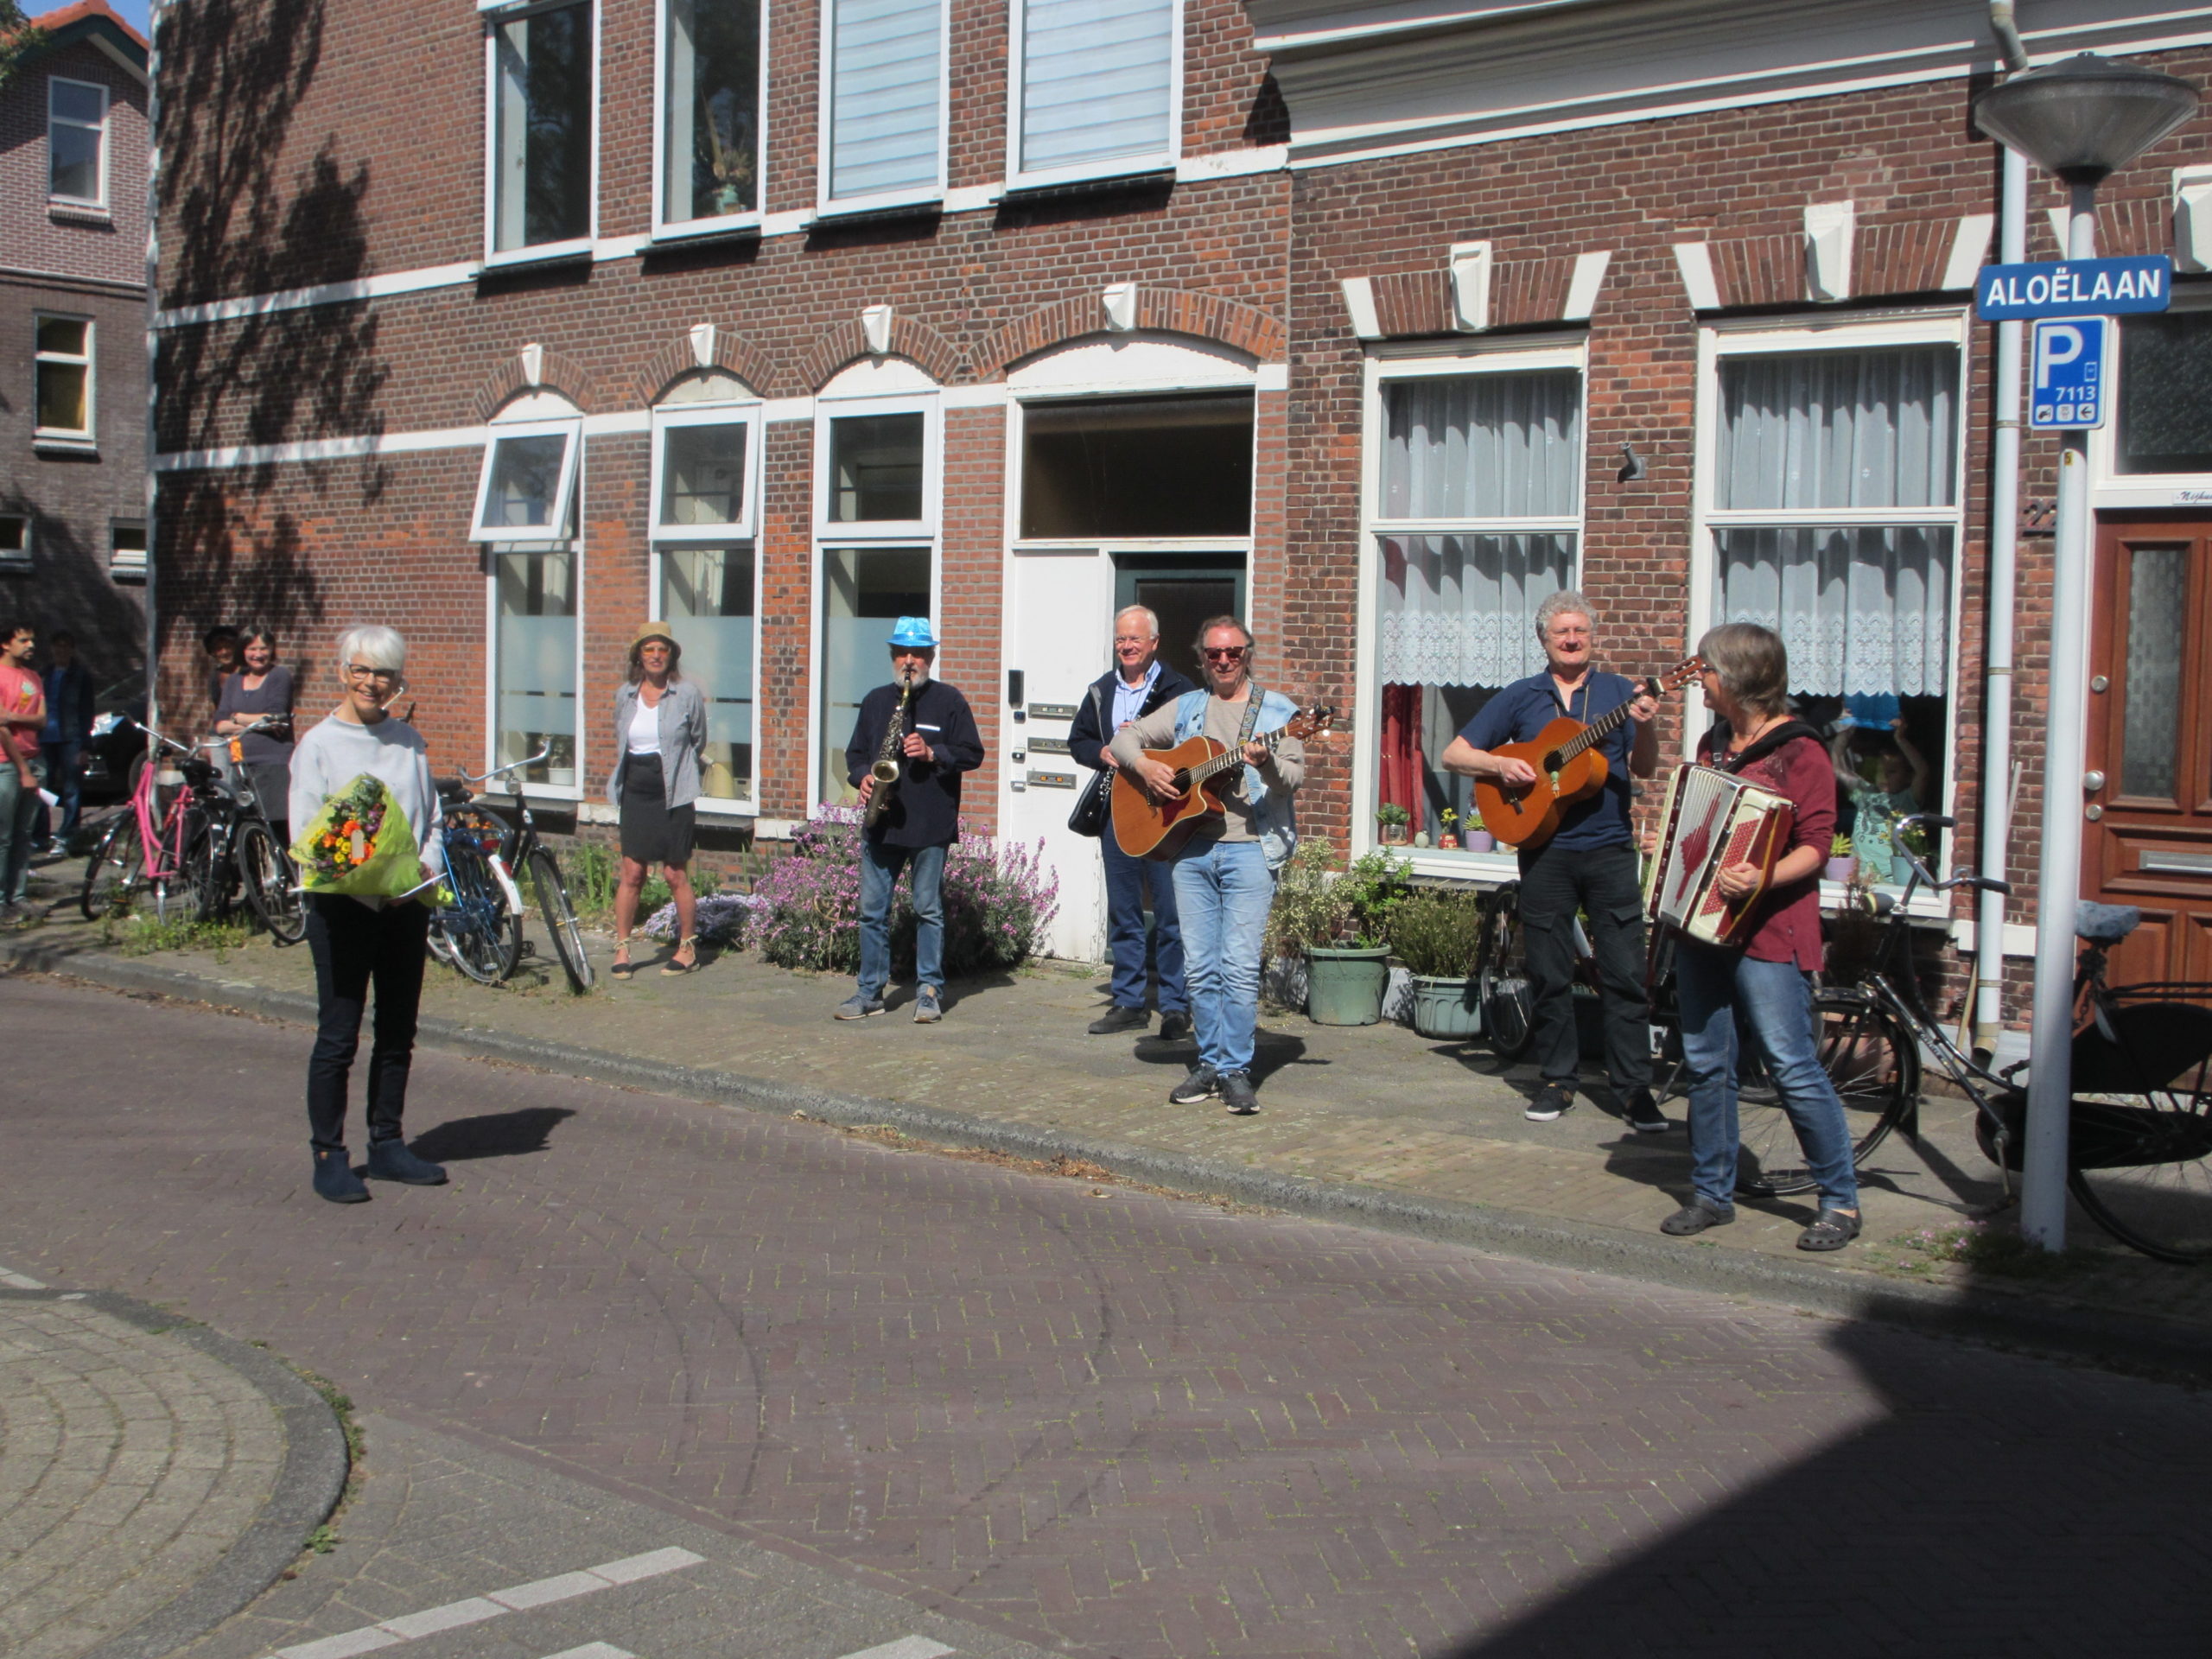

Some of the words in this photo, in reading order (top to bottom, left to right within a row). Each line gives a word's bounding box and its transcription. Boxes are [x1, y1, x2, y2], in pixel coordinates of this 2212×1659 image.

[1986, 267, 2161, 307] ALOËLAAN
[2037, 325, 2083, 389] P
[2056, 386, 2096, 402] 7113
